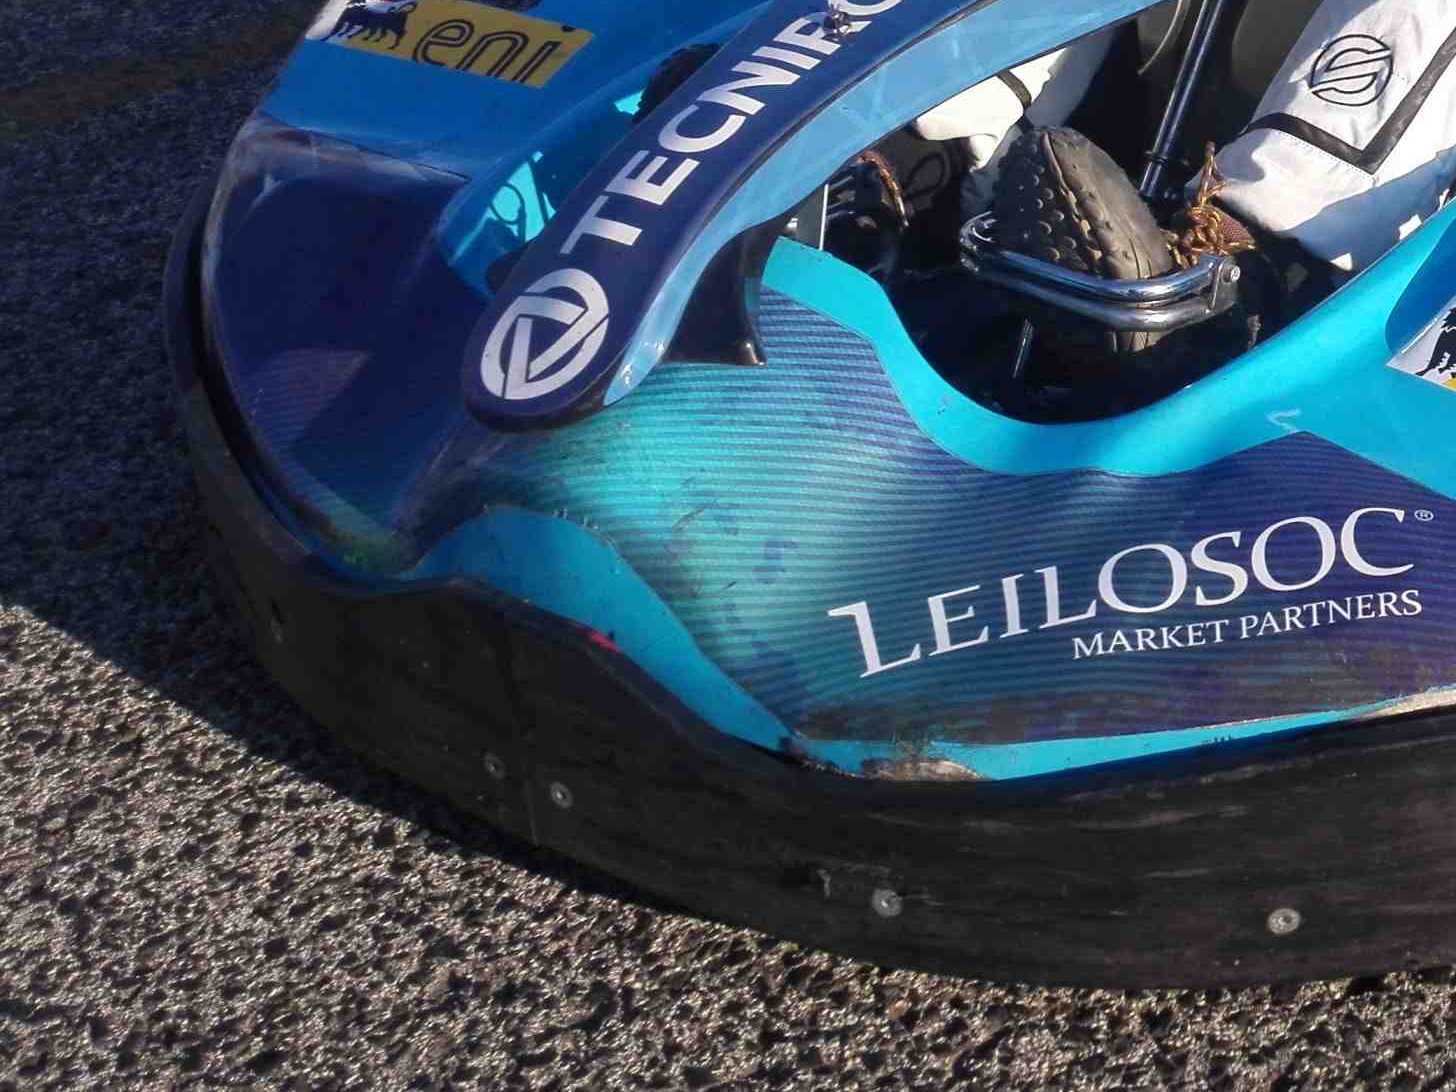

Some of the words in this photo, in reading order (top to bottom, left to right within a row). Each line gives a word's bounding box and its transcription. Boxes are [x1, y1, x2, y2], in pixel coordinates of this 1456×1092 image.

[412, 18, 576, 83] eni
[1072, 619, 1229, 659] MARKET
[1240, 589, 1423, 639] PARTNERS
